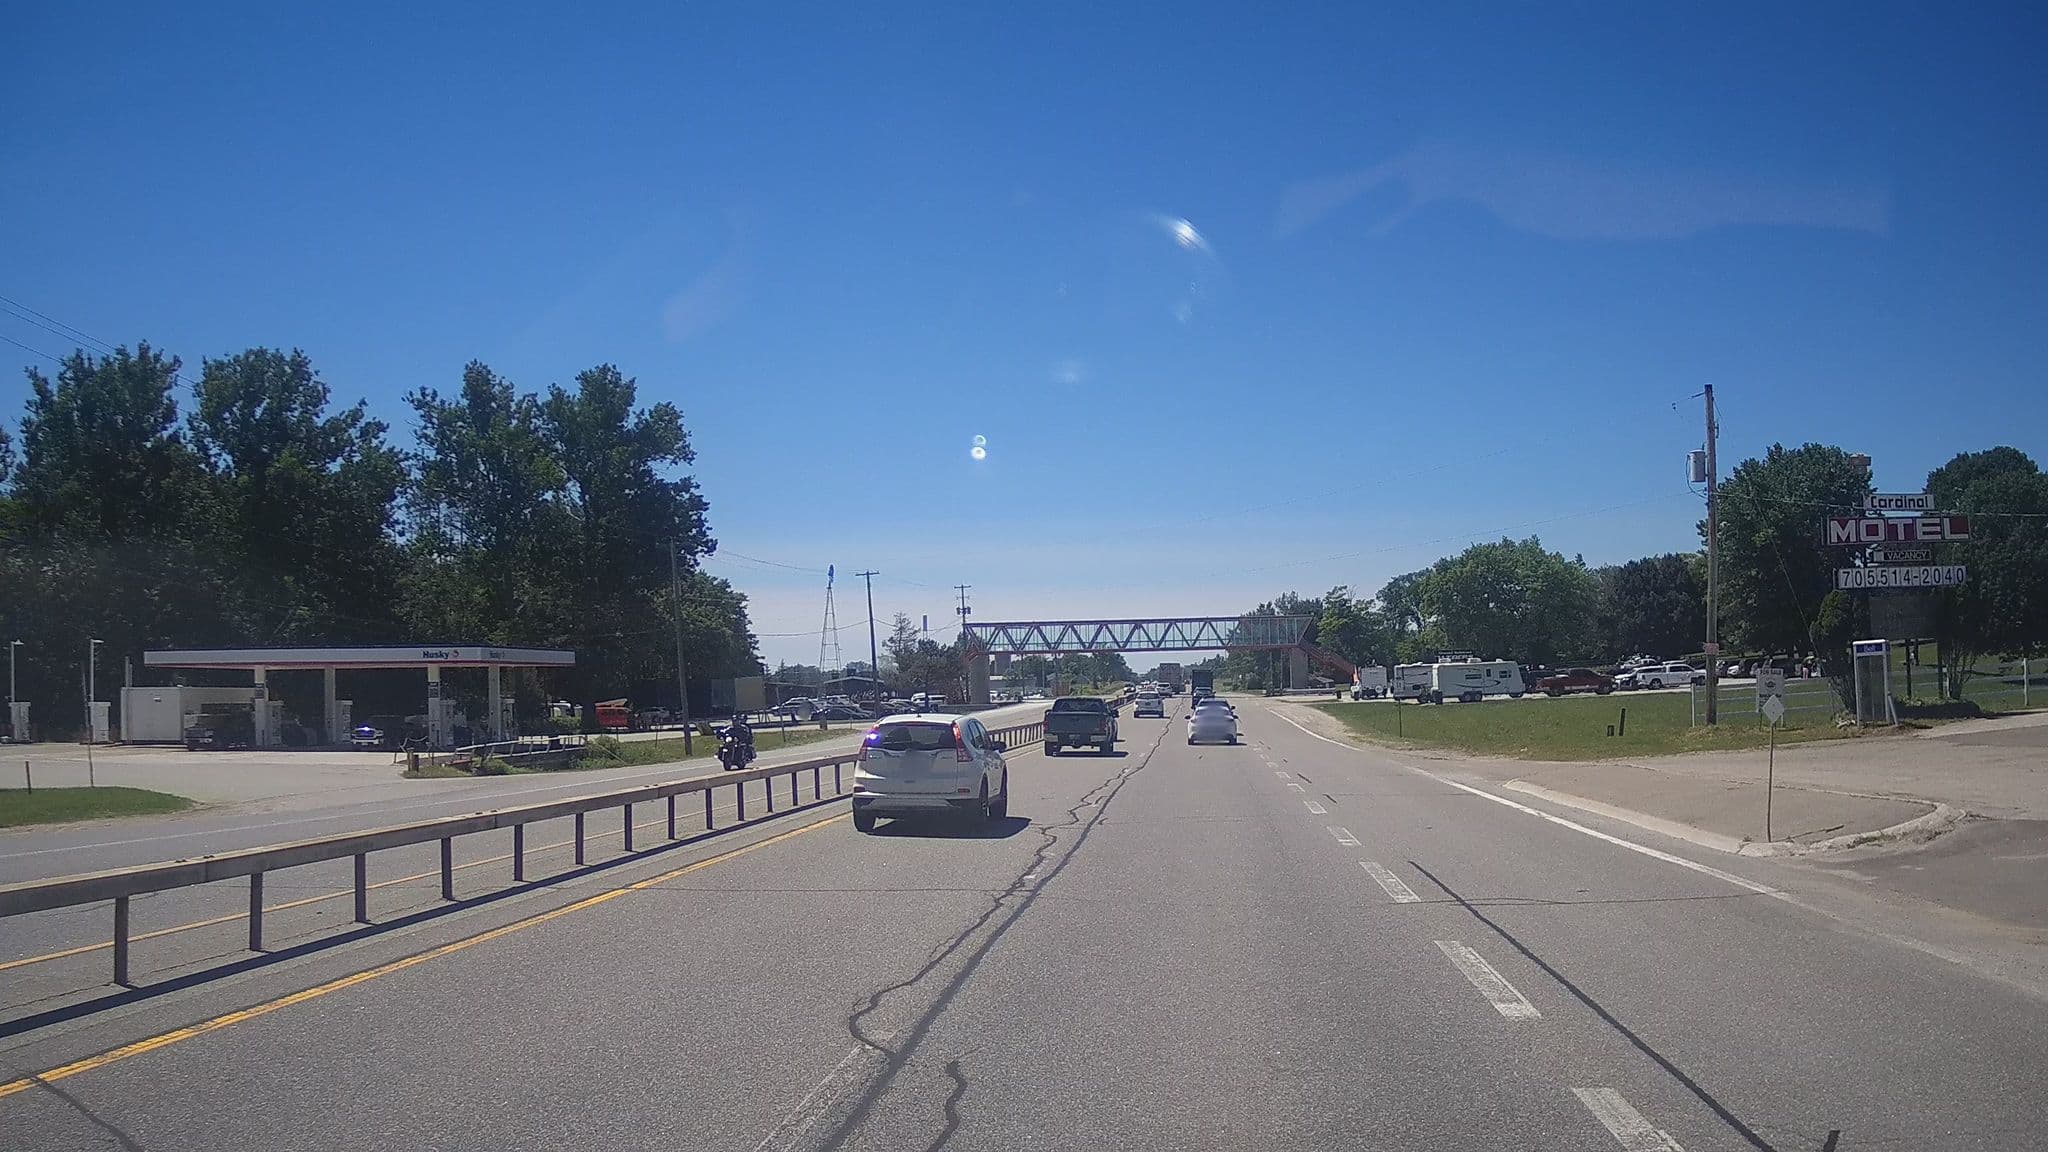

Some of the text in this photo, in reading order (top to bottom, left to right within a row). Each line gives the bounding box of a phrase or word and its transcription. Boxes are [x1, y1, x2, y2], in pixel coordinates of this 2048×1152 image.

[1870, 495, 1929, 509] Cardinal
[1829, 517, 1970, 543] MOTEL
[1887, 551, 1927, 561] VACANCY
[422, 650, 449, 660] Husky
